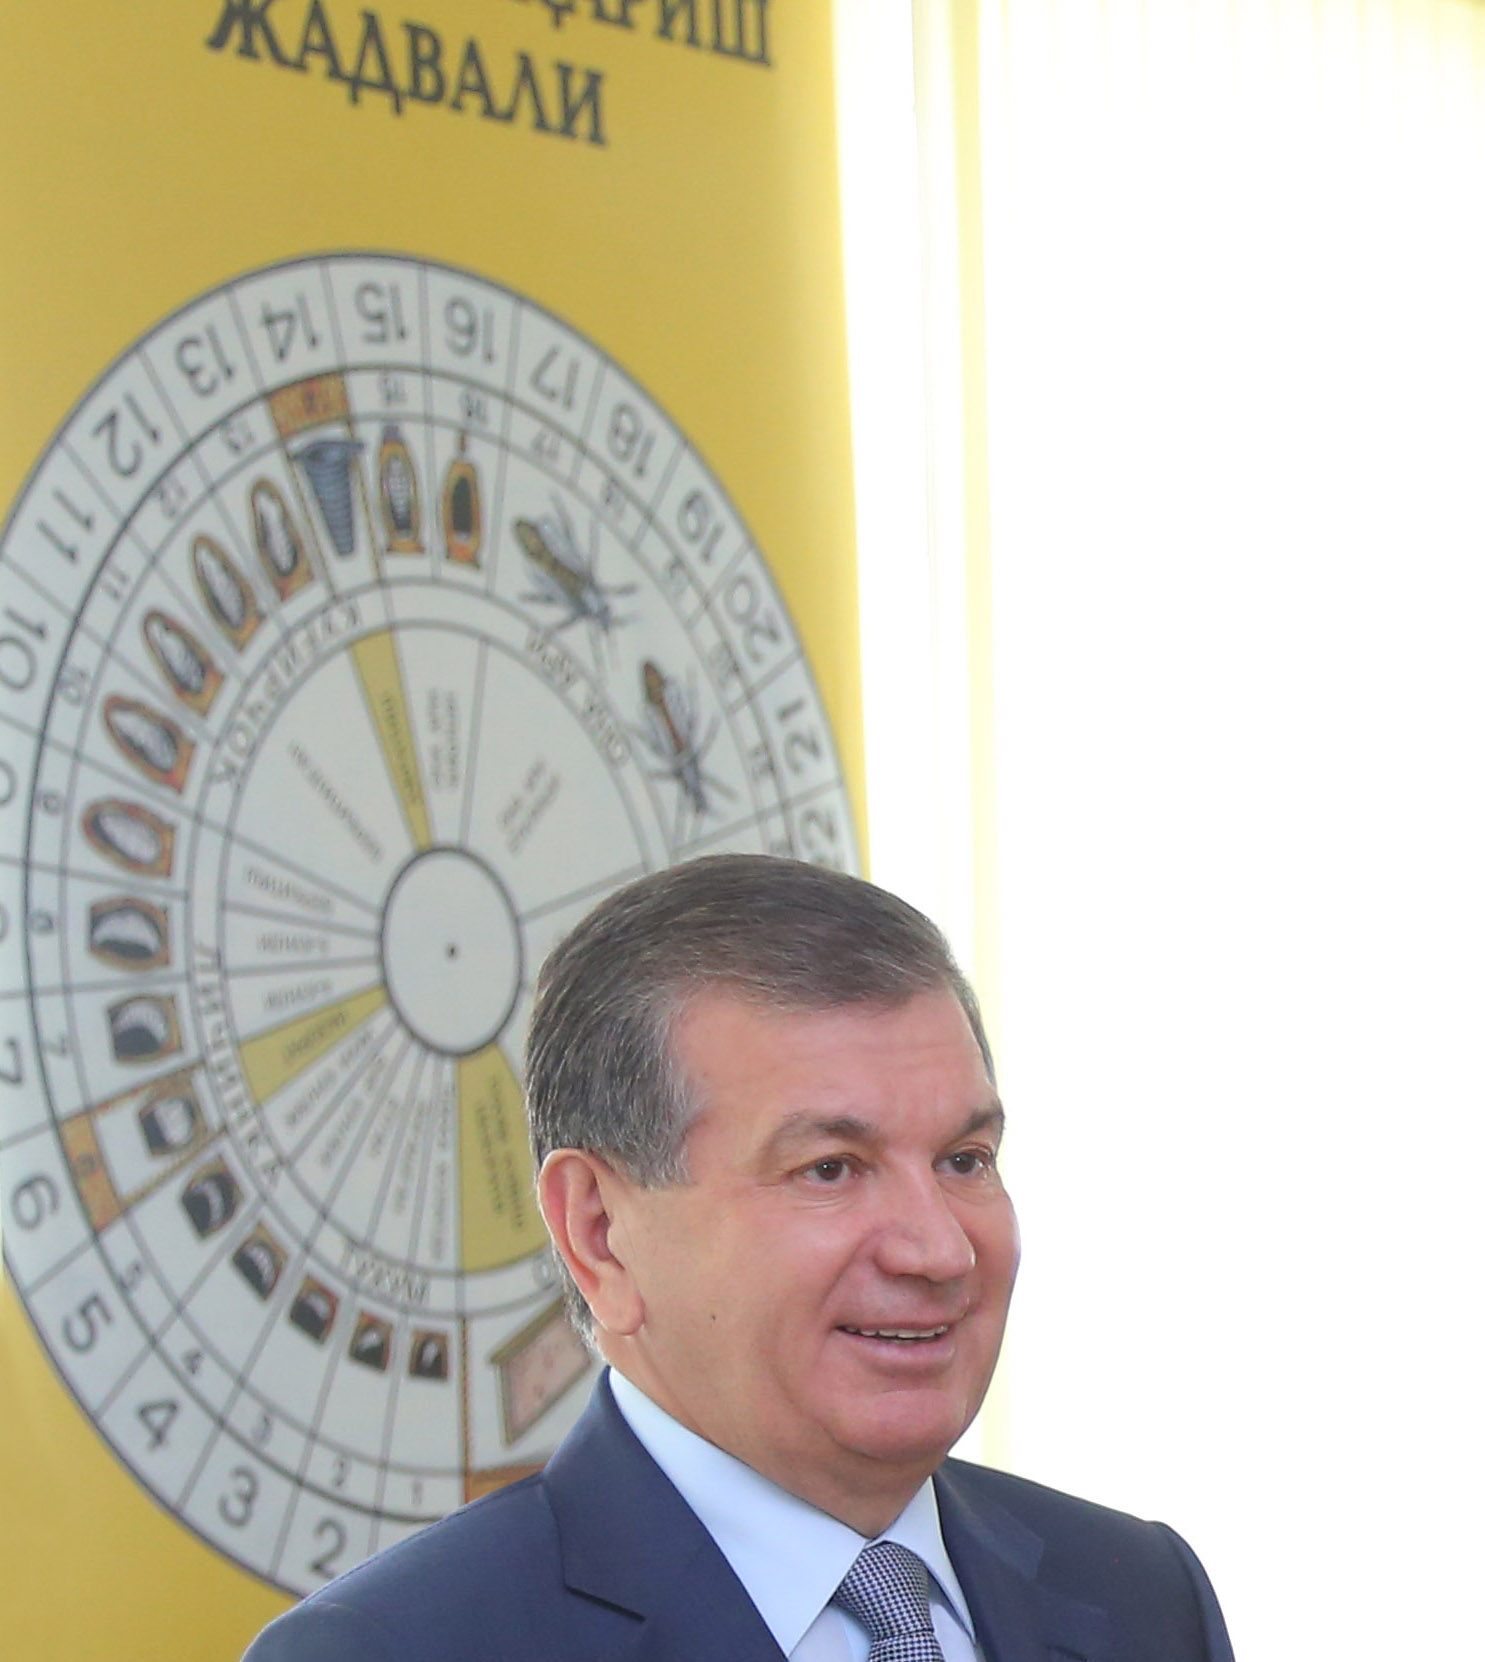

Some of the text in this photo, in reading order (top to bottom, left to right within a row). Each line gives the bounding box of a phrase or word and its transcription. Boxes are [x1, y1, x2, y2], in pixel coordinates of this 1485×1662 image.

[206, 0, 607, 147] ЖАДВАЛИ
[261, 292, 320, 362] 14
[354, 282, 408, 344] 15
[443, 295, 495, 363] 16
[174, 324, 236, 397] 13
[528, 346, 580, 411] 17
[91, 391, 163, 478] 12
[605, 402, 657, 478] 18
[36, 487, 95, 565] 11
[676, 487, 727, 563] 19
[0, 607, 47, 693] 10
[724, 573, 782, 664] 20
[775, 696, 822, 776] 21
[9, 1173, 61, 1232] 6
[62, 1294, 114, 1354] 5
[137, 1401, 180, 1450] 4
[217, 1466, 261, 1530] 3
[308, 1516, 349, 1581] 2
